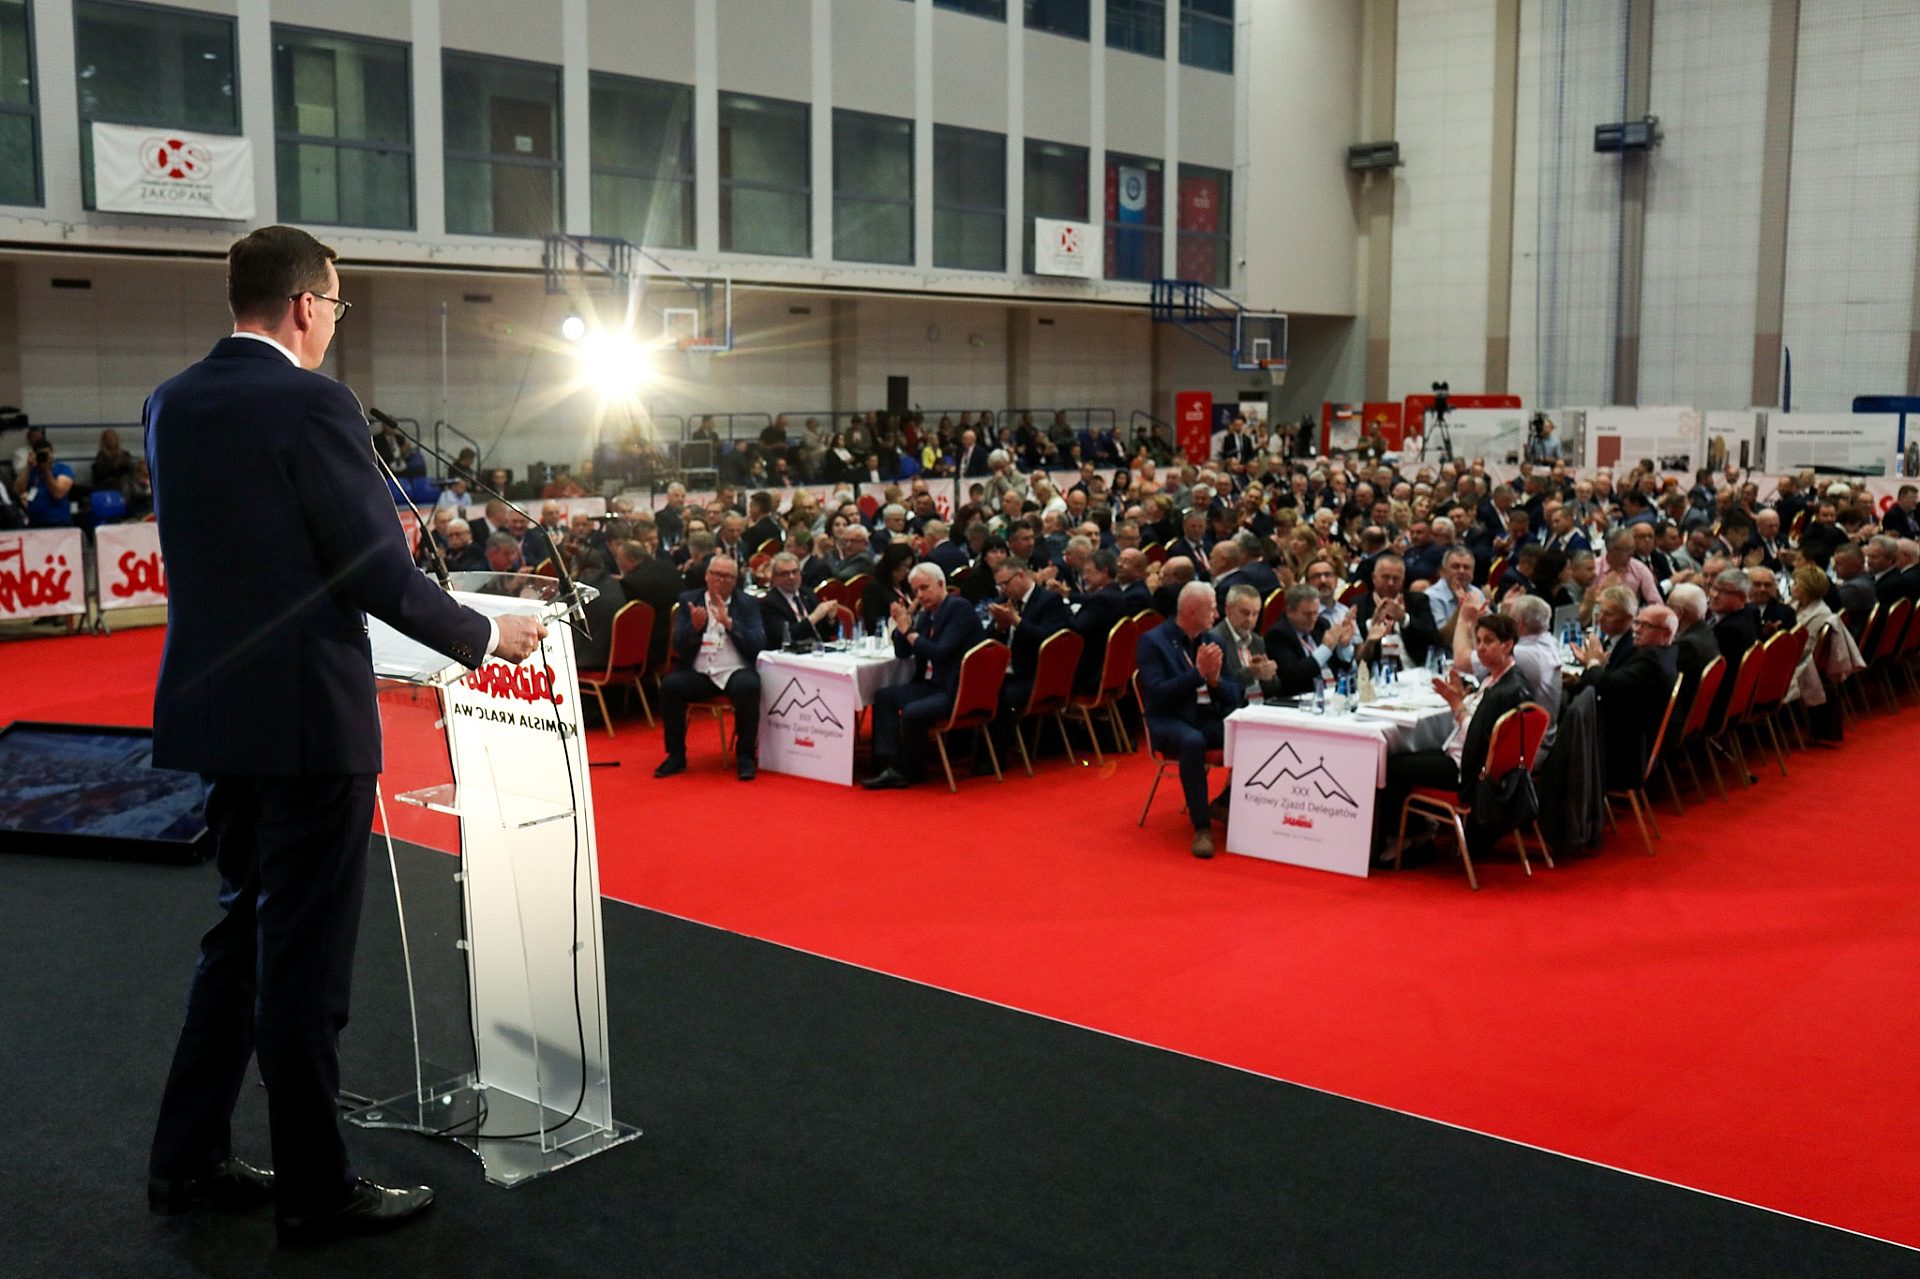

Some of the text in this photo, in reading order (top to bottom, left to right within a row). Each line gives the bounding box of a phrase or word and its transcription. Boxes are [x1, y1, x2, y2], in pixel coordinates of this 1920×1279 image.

[1292, 786, 1310, 796] XXX
[1244, 793, 1357, 819] Krajowy Zjazd Delegatów
